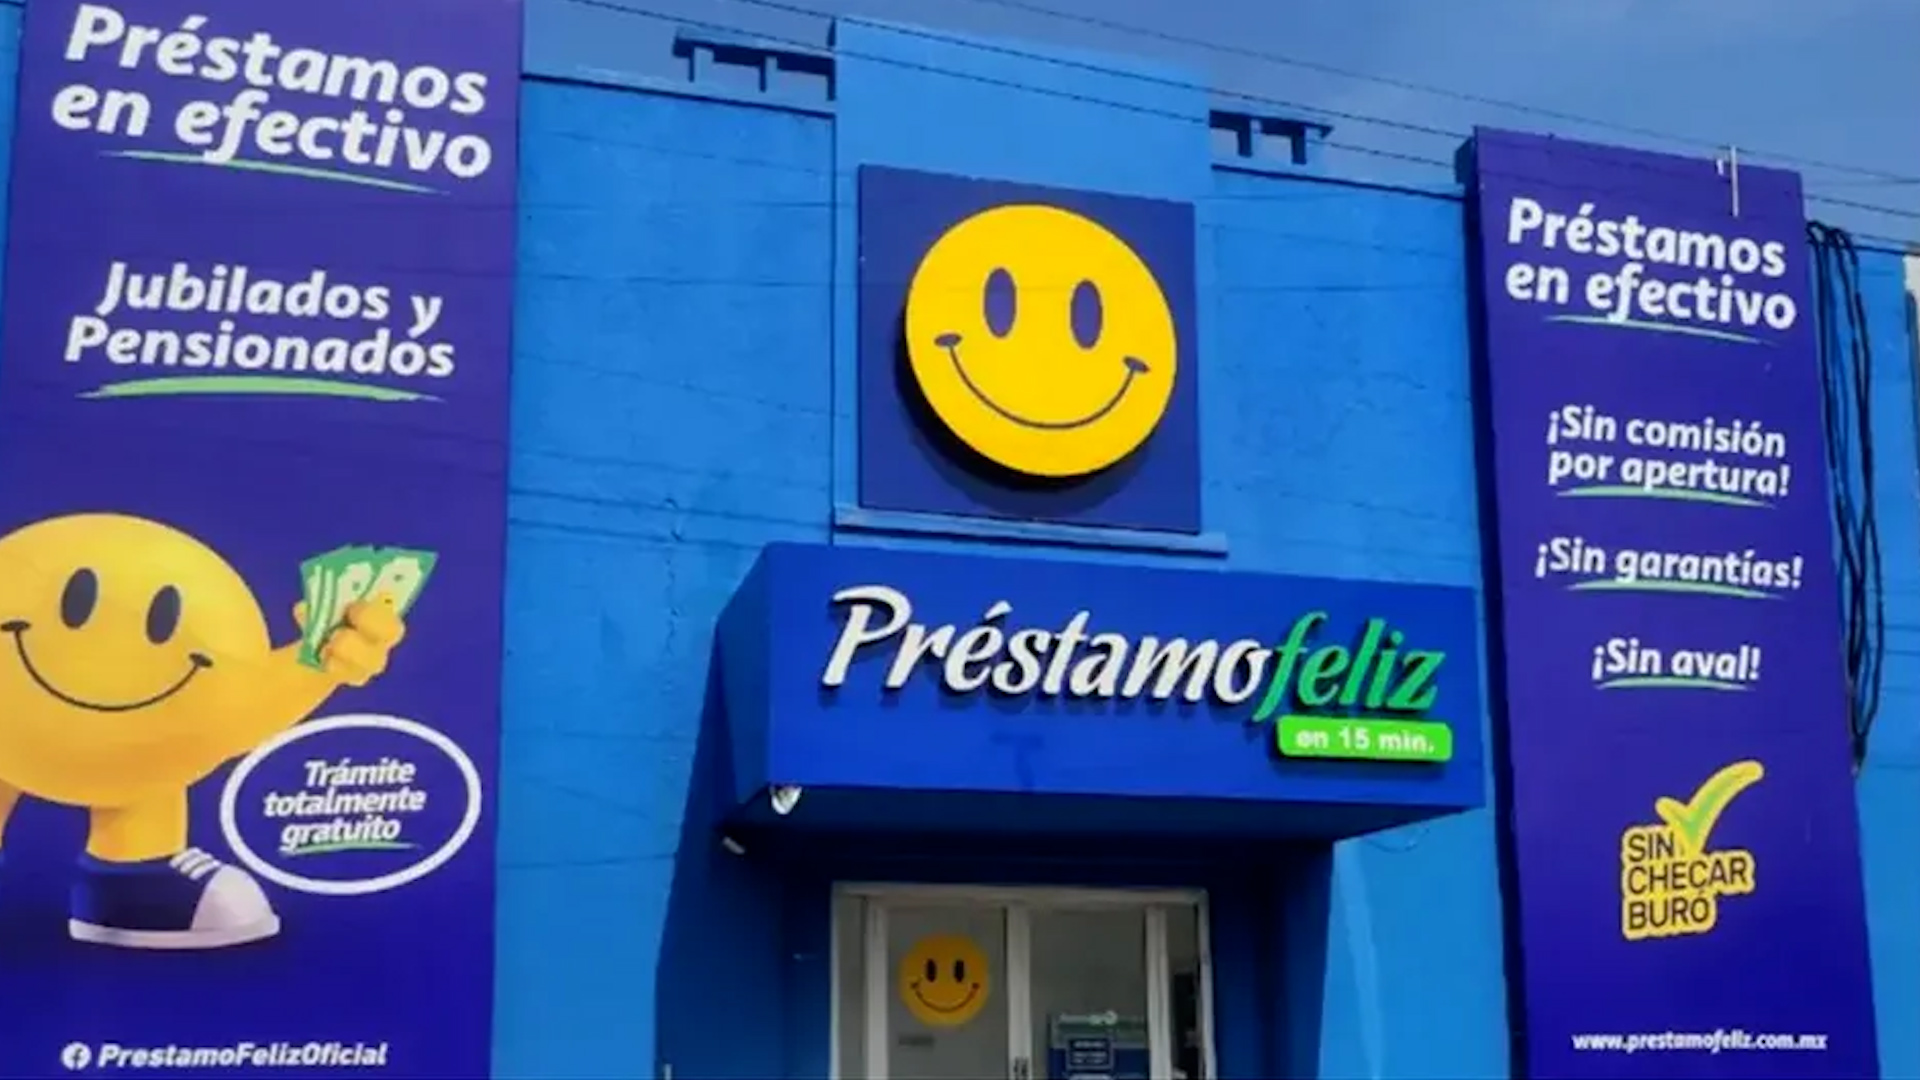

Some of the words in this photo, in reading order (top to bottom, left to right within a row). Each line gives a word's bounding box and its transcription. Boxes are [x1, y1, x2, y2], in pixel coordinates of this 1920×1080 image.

[64, 3, 488, 115] Préstamos
[51, 83, 151, 136] en
[174, 89, 492, 178] efectivo
[1507, 197, 1787, 278] Préstamos
[96, 262, 390, 321] Jubilados
[408, 295, 443, 338] y
[1505, 261, 1569, 304] en
[1585, 263, 1797, 330] efectivo
[64, 315, 455, 378] Pensionados
[1547, 404, 1617, 445] ¡Sin
[1626, 416, 1786, 458] comisión
[1548, 449, 1614, 485] por
[1620, 456, 1791, 497] apertura!
[1535, 537, 1606, 578] ¡Sin
[1614, 548, 1803, 589] garantías!
[1592, 638, 1661, 680] ¡Sin
[1671, 647, 1762, 681] aval!
[1296, 730, 1329, 749] en
[1338, 726, 1371, 749] 15
[1379, 730, 1435, 753] min.
[304, 758, 416, 788] Trámite
[263, 785, 427, 818] totalmente
[280, 815, 401, 850] gratuito
[1627, 832, 1675, 863] SIN
[1627, 856, 1748, 894] CHECAR
[1628, 889, 1710, 930] BURÓ
[98, 1041, 387, 1068] PrestamoFelizOficial
[1572, 1029, 1828, 1055] www.prestamofeliz.com.mx
